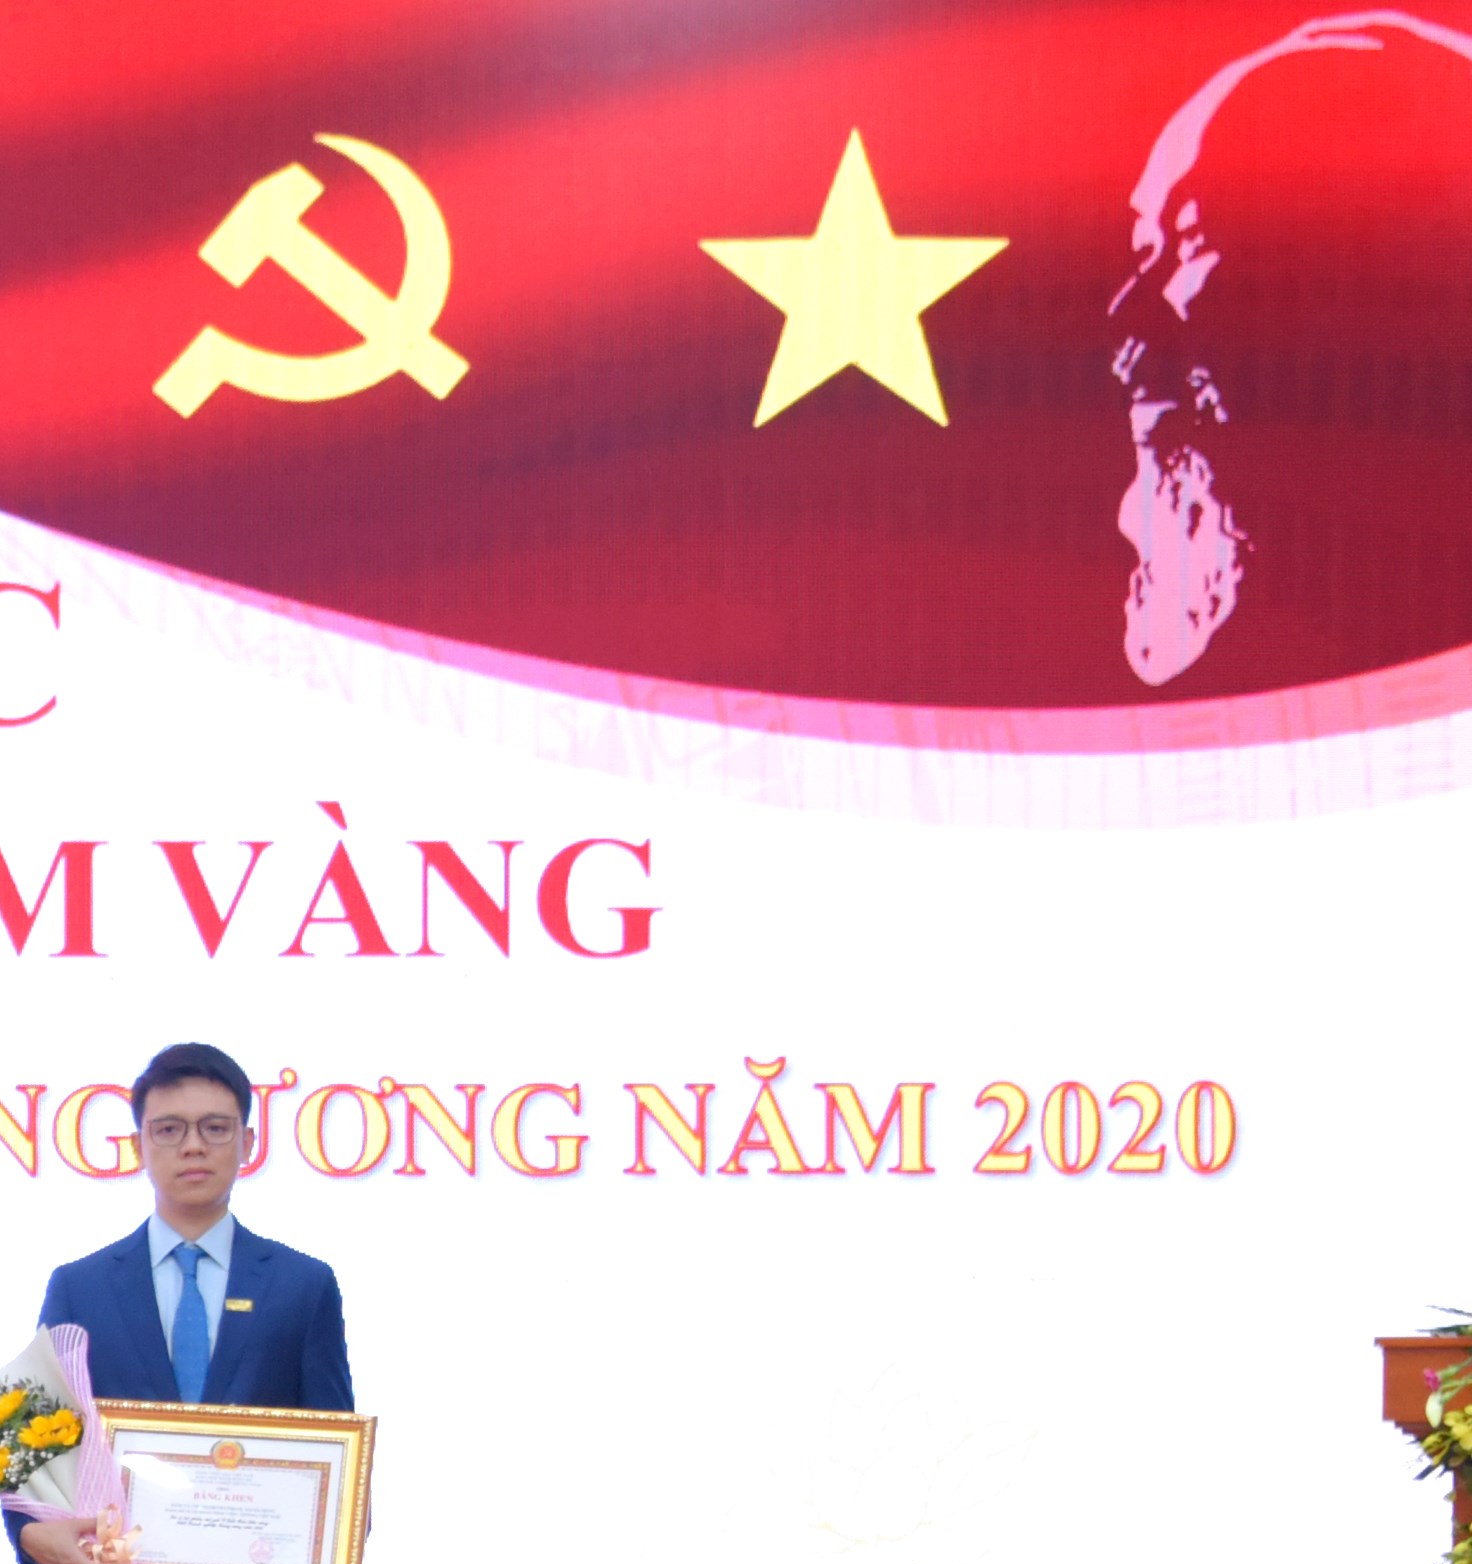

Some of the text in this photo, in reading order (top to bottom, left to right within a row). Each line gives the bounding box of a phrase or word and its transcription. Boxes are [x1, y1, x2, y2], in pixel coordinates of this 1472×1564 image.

[152, 800, 662, 960] VÀNG
[622, 1056, 938, 1178] NĂM
[973, 1079, 1239, 1178] 2020
